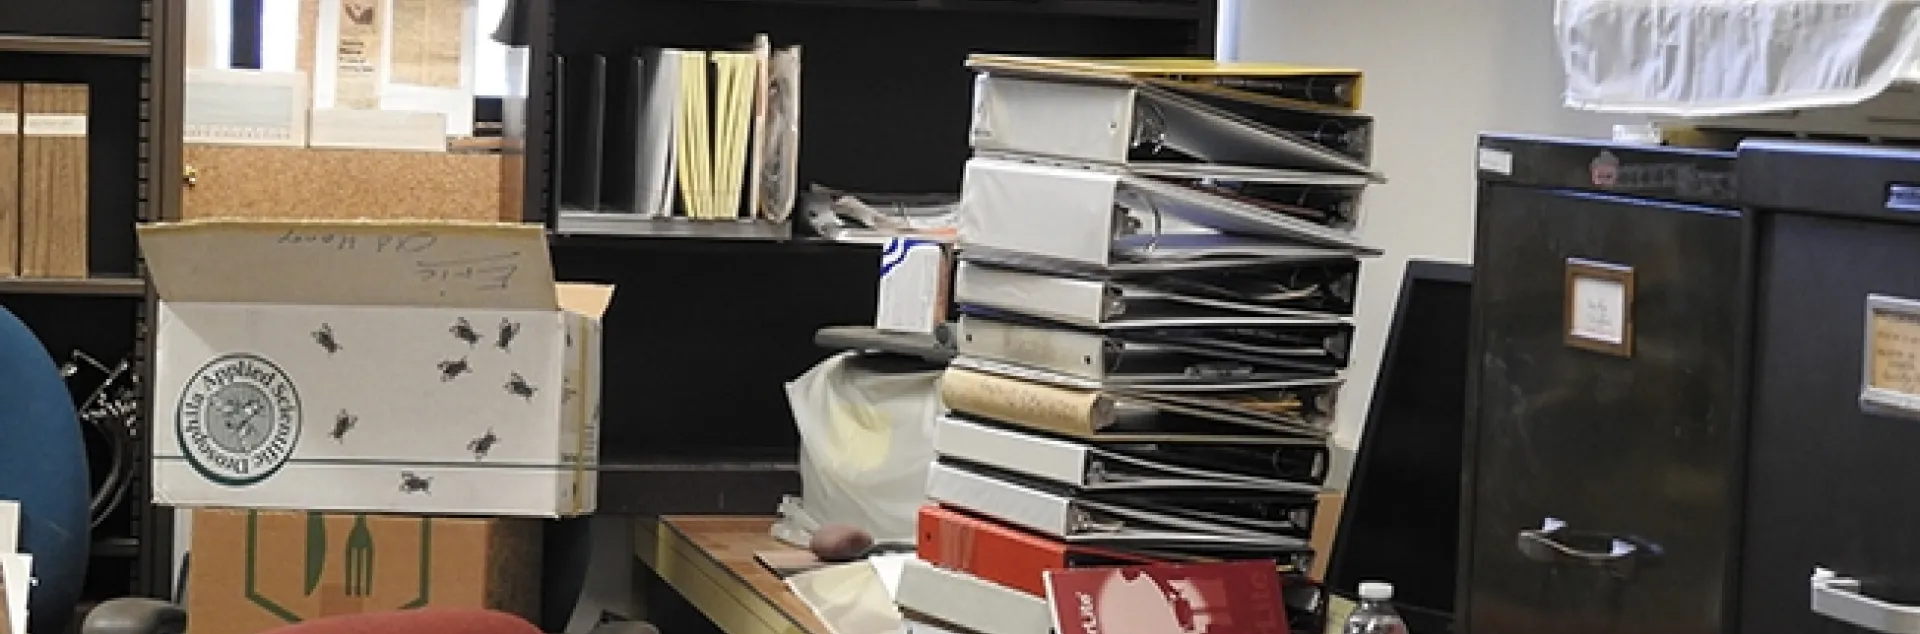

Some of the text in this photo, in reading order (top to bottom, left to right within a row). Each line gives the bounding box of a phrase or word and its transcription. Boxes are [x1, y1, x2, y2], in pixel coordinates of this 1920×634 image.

[416, 264, 518, 297] Eric
[186, 360, 296, 474] Applied Scientific Drosophila
